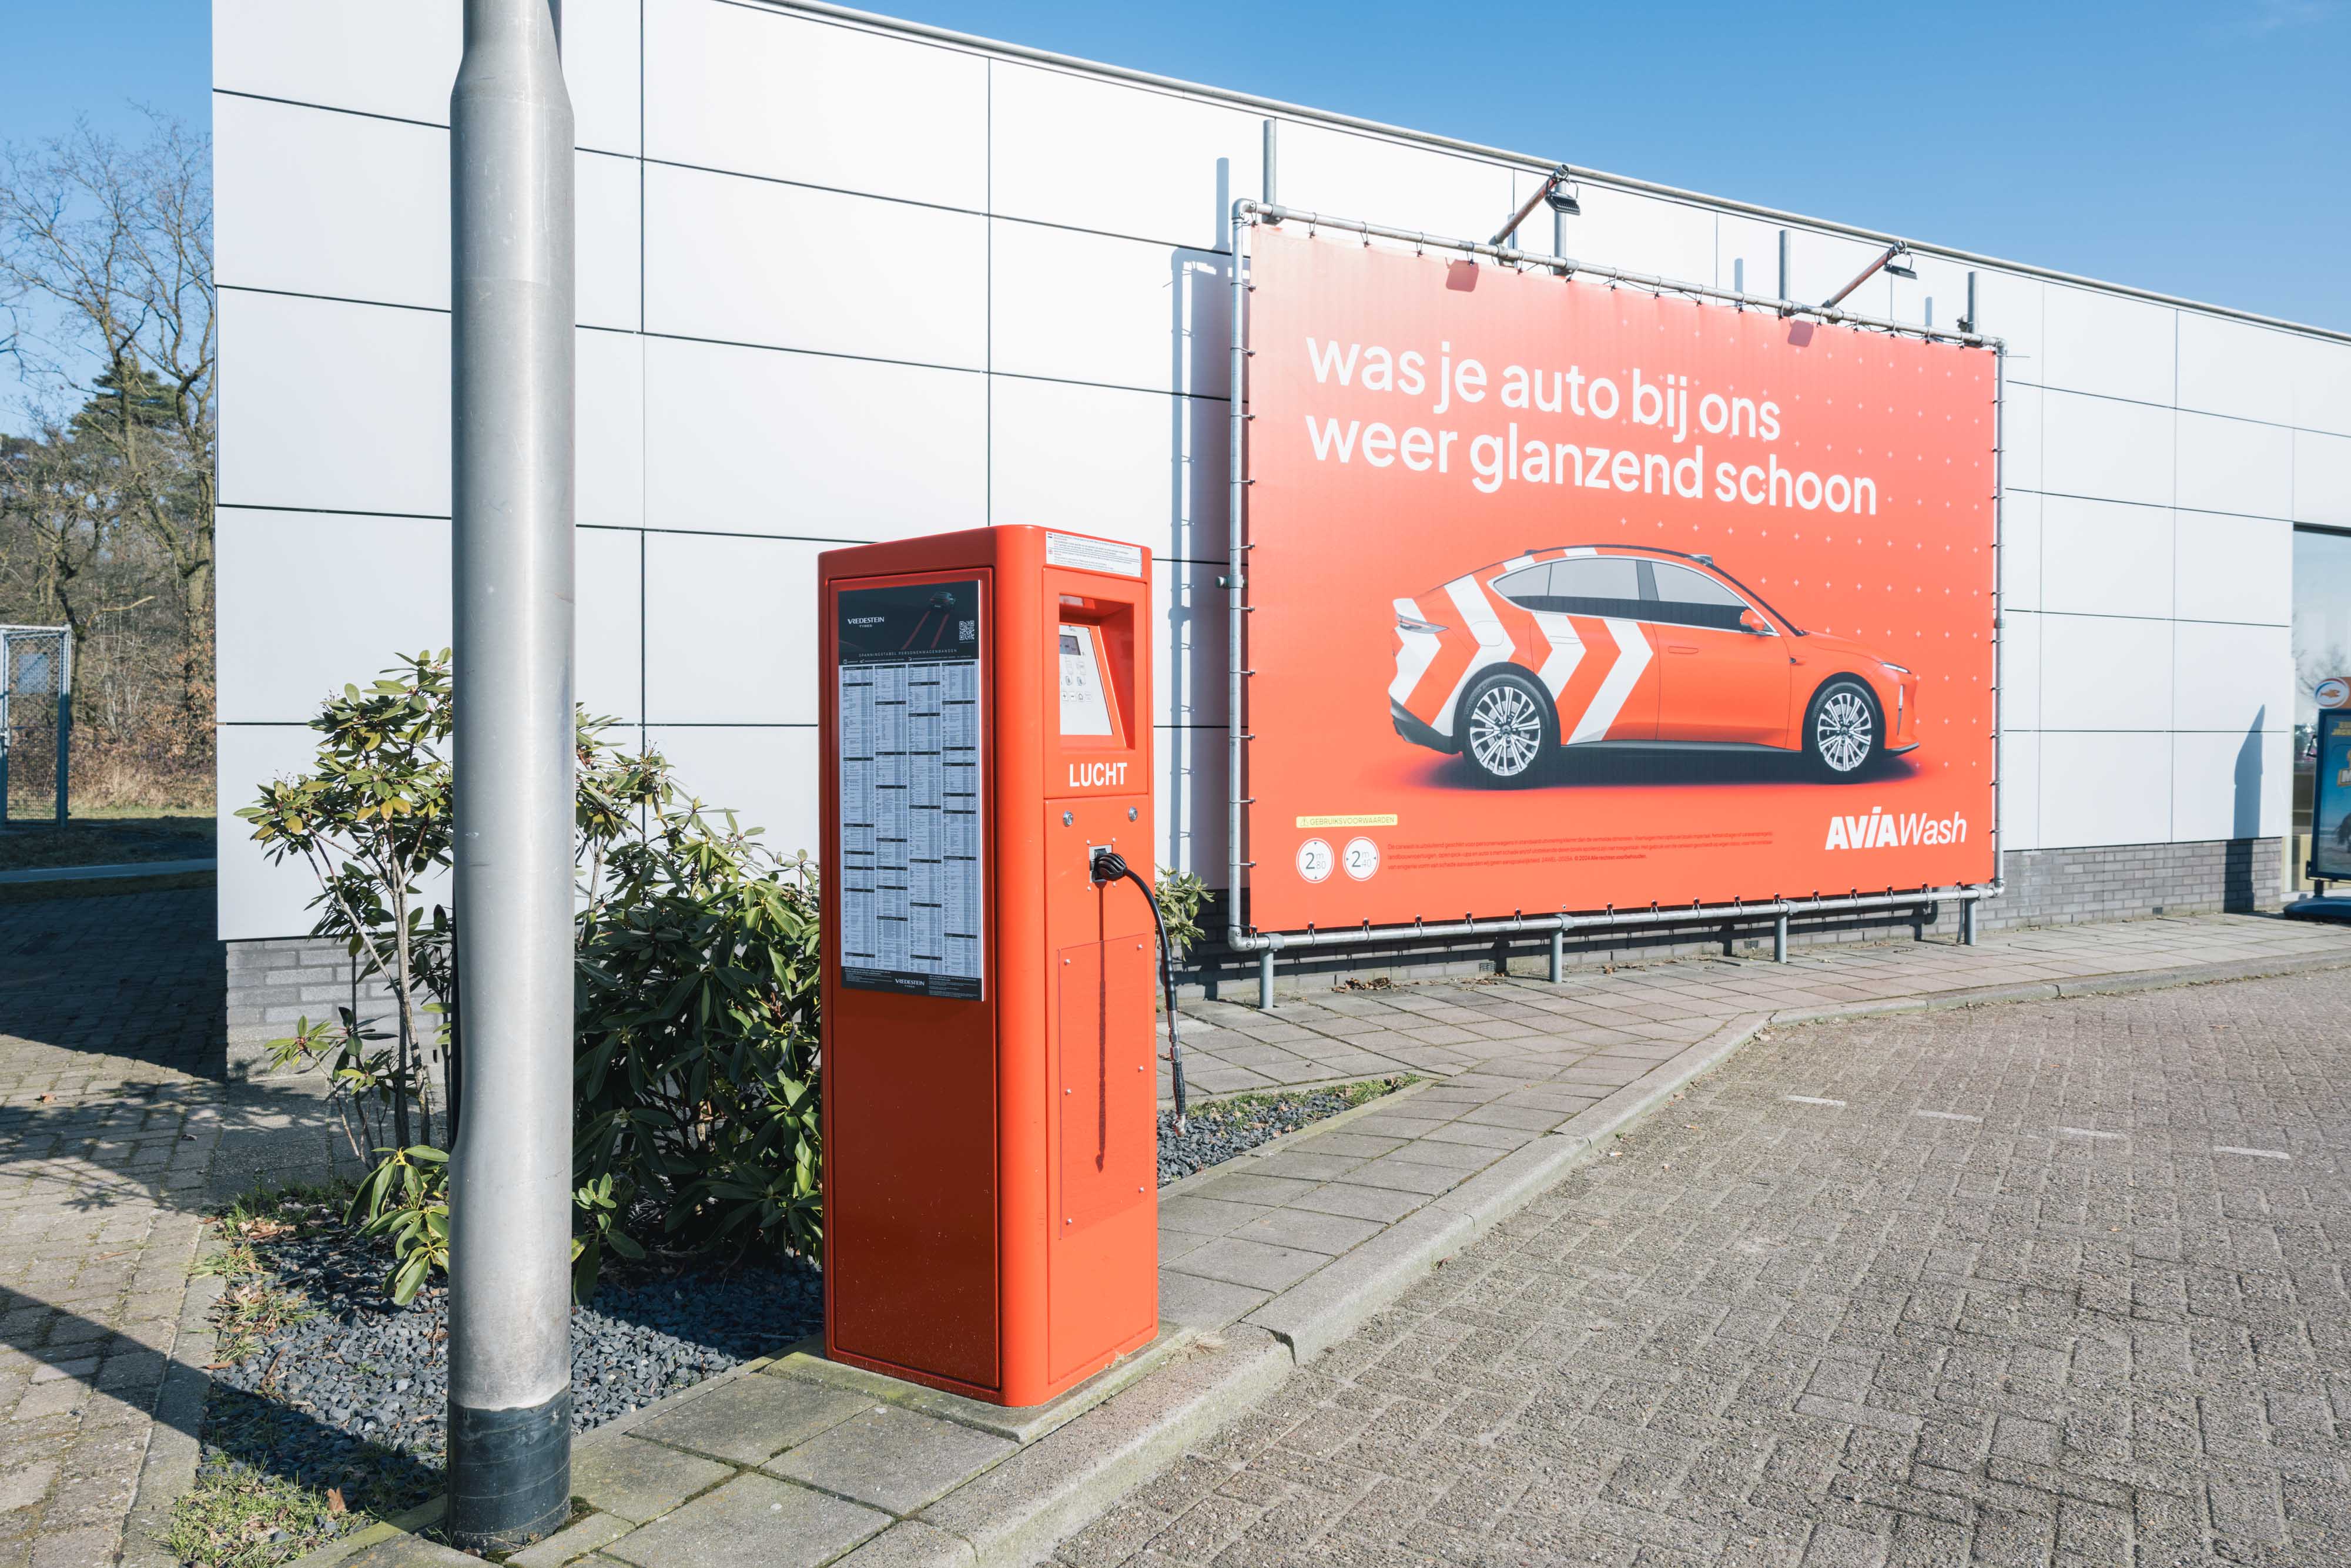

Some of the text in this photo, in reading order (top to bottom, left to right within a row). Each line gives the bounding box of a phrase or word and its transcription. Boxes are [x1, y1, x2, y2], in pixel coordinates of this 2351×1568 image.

[1305, 337, 1780, 443] was je auto bij ons
[1305, 414, 1877, 515] weer glanzend schoon
[1069, 762, 1128, 788] LUCHT
[1310, 816, 1395, 826] GEBRUIKSVOORWAARDEN
[1900, 811, 1967, 846] Wash
[1305, 852, 1315, 870] 2
[1316, 860, 1327, 870] 80
[1351, 850, 1361, 867] 2
[1361, 859, 1372, 868] 40
[895, 978, 925, 986] VREDESTEIN
